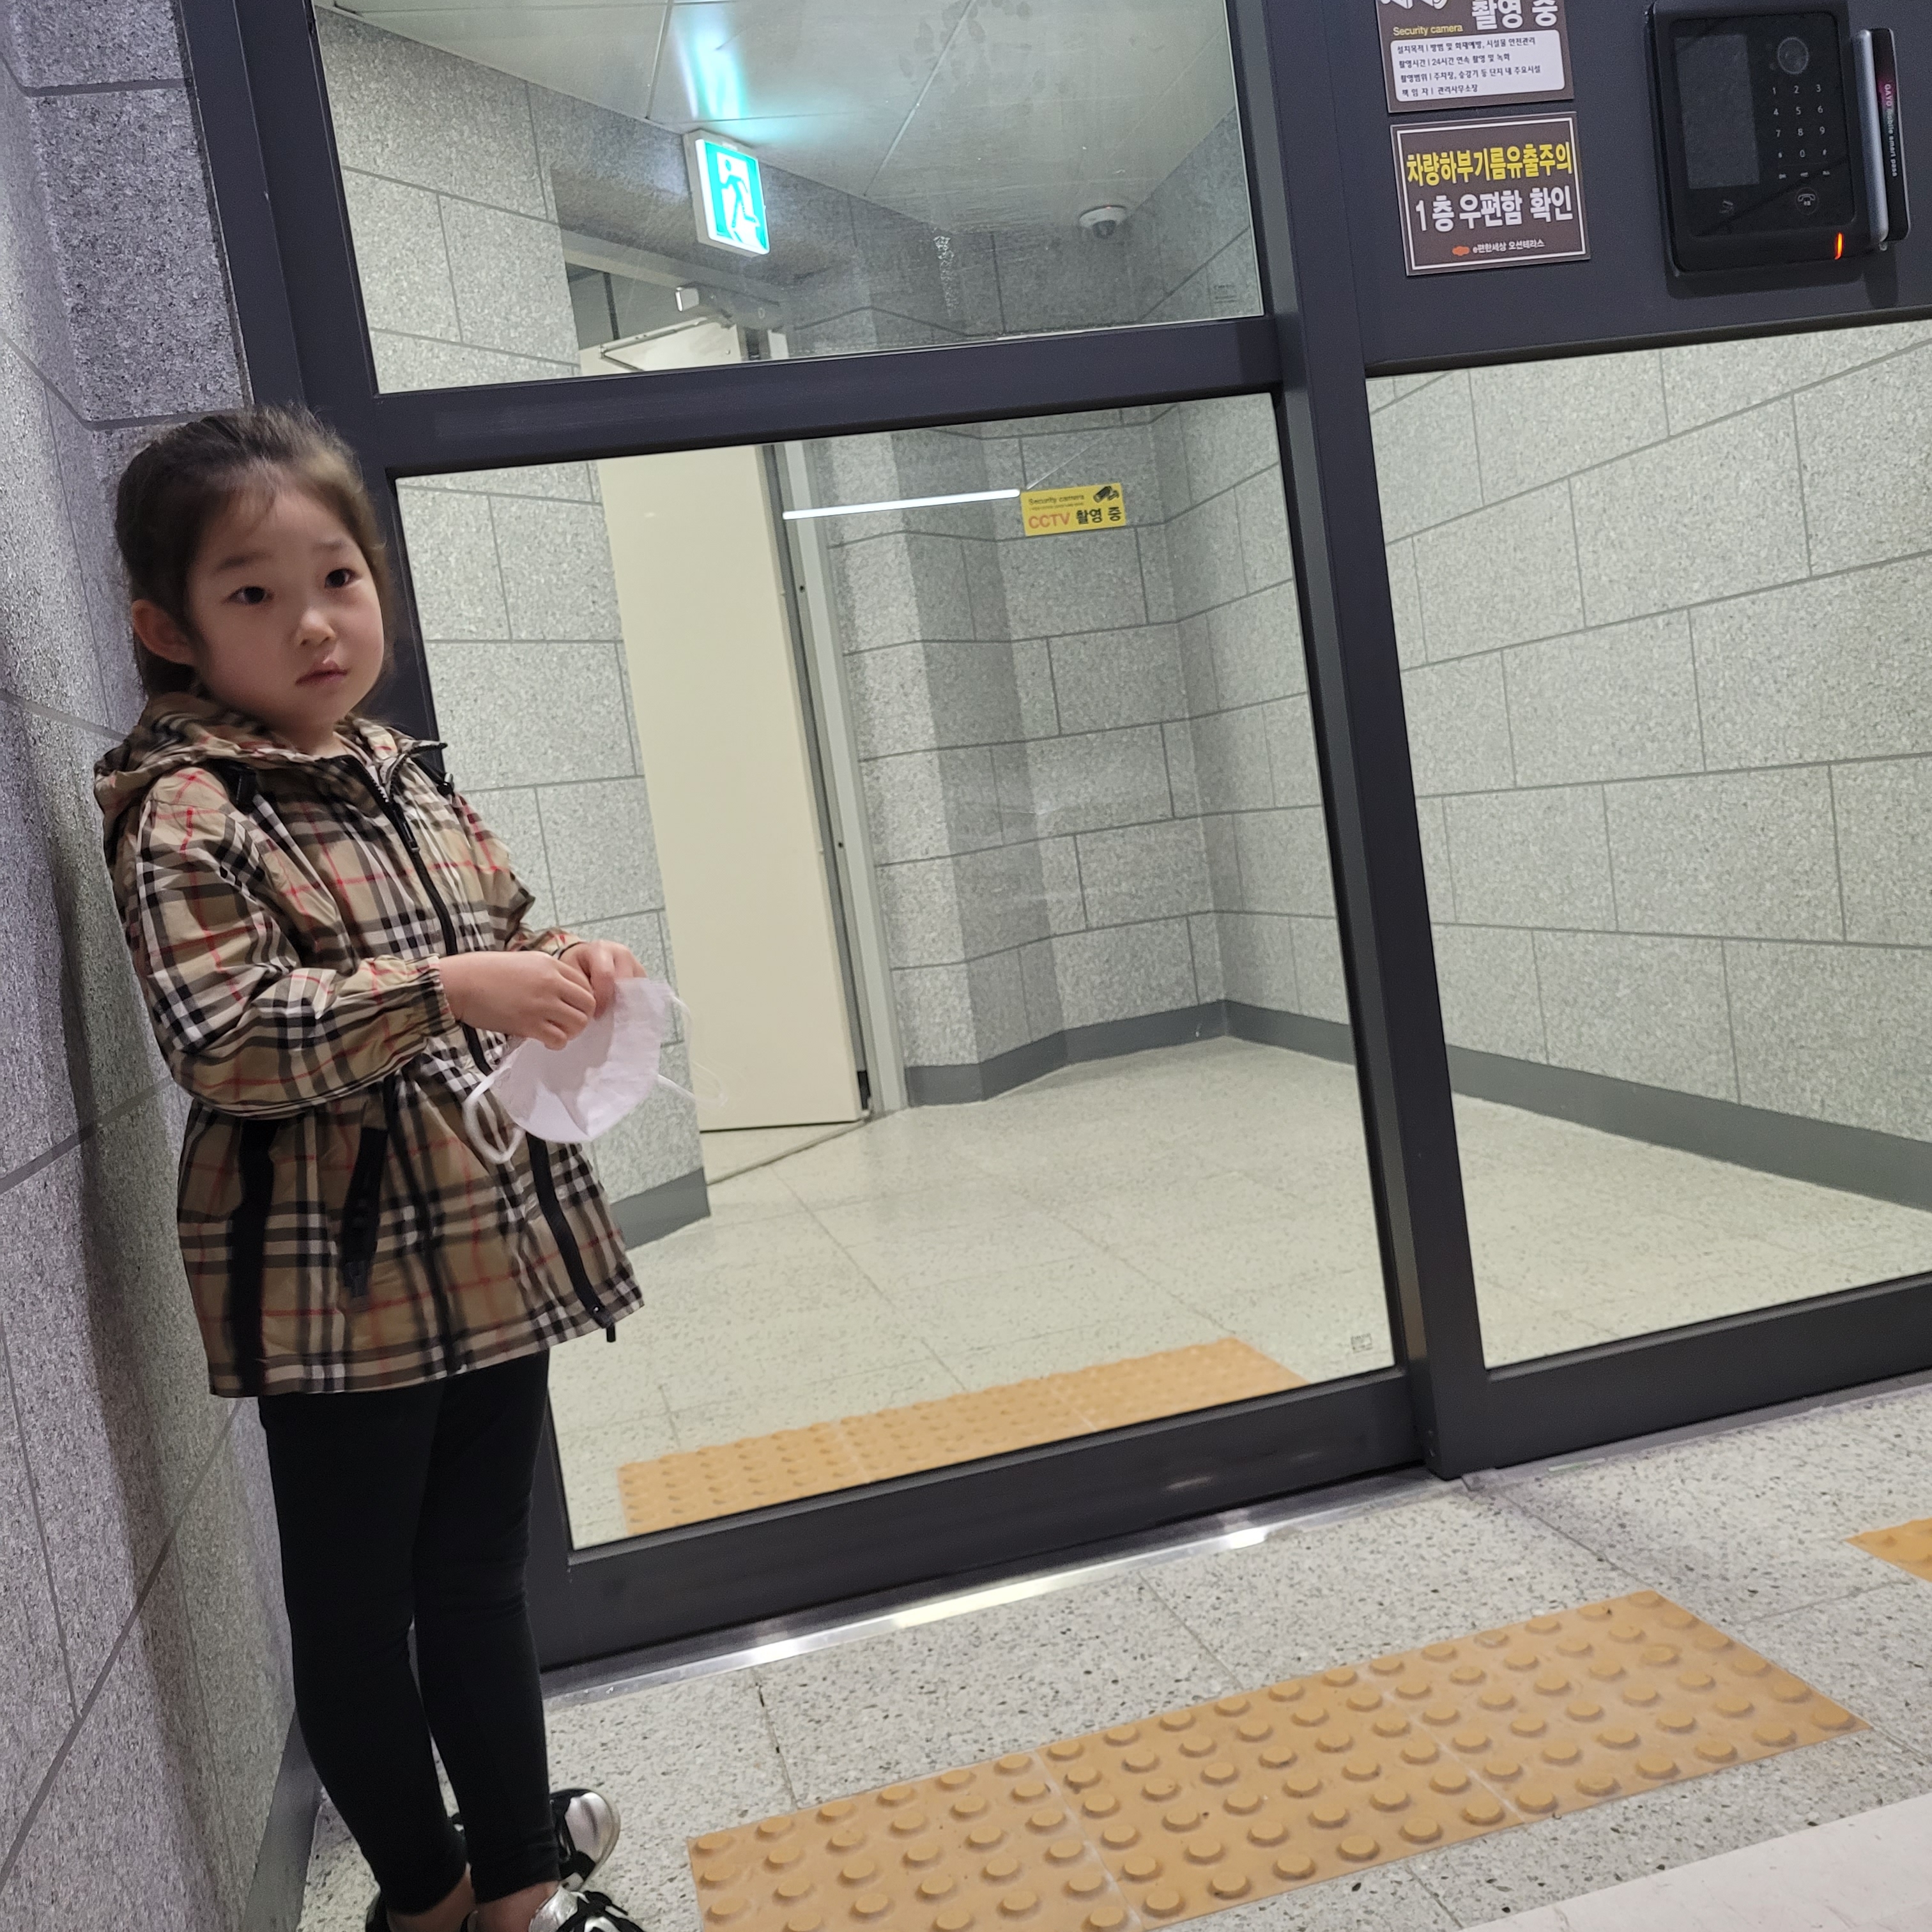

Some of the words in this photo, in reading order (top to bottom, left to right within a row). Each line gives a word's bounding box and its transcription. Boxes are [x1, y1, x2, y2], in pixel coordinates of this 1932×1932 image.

[1393, 26, 1428, 36] Security
[1430, 24, 1463, 34] camera
[1432, 57, 1455, 66] 24시간
[1794, 85, 1799, 94] 2
[1816, 84, 1821, 93] 3
[1796, 106, 1801, 114] 5
[1820, 126, 1825, 135] 9
[1800, 150, 1805, 158] 0
[1459, 189, 1522, 229] 우편함
[1529, 185, 1573, 223] 확인
[1029, 496, 1057, 505] Security
[1059, 494, 1084, 503] camera
[1028, 512, 1070, 529] CCTV
[1077, 508, 1103, 525] 촬영
[1108, 506, 1122, 522] 중
